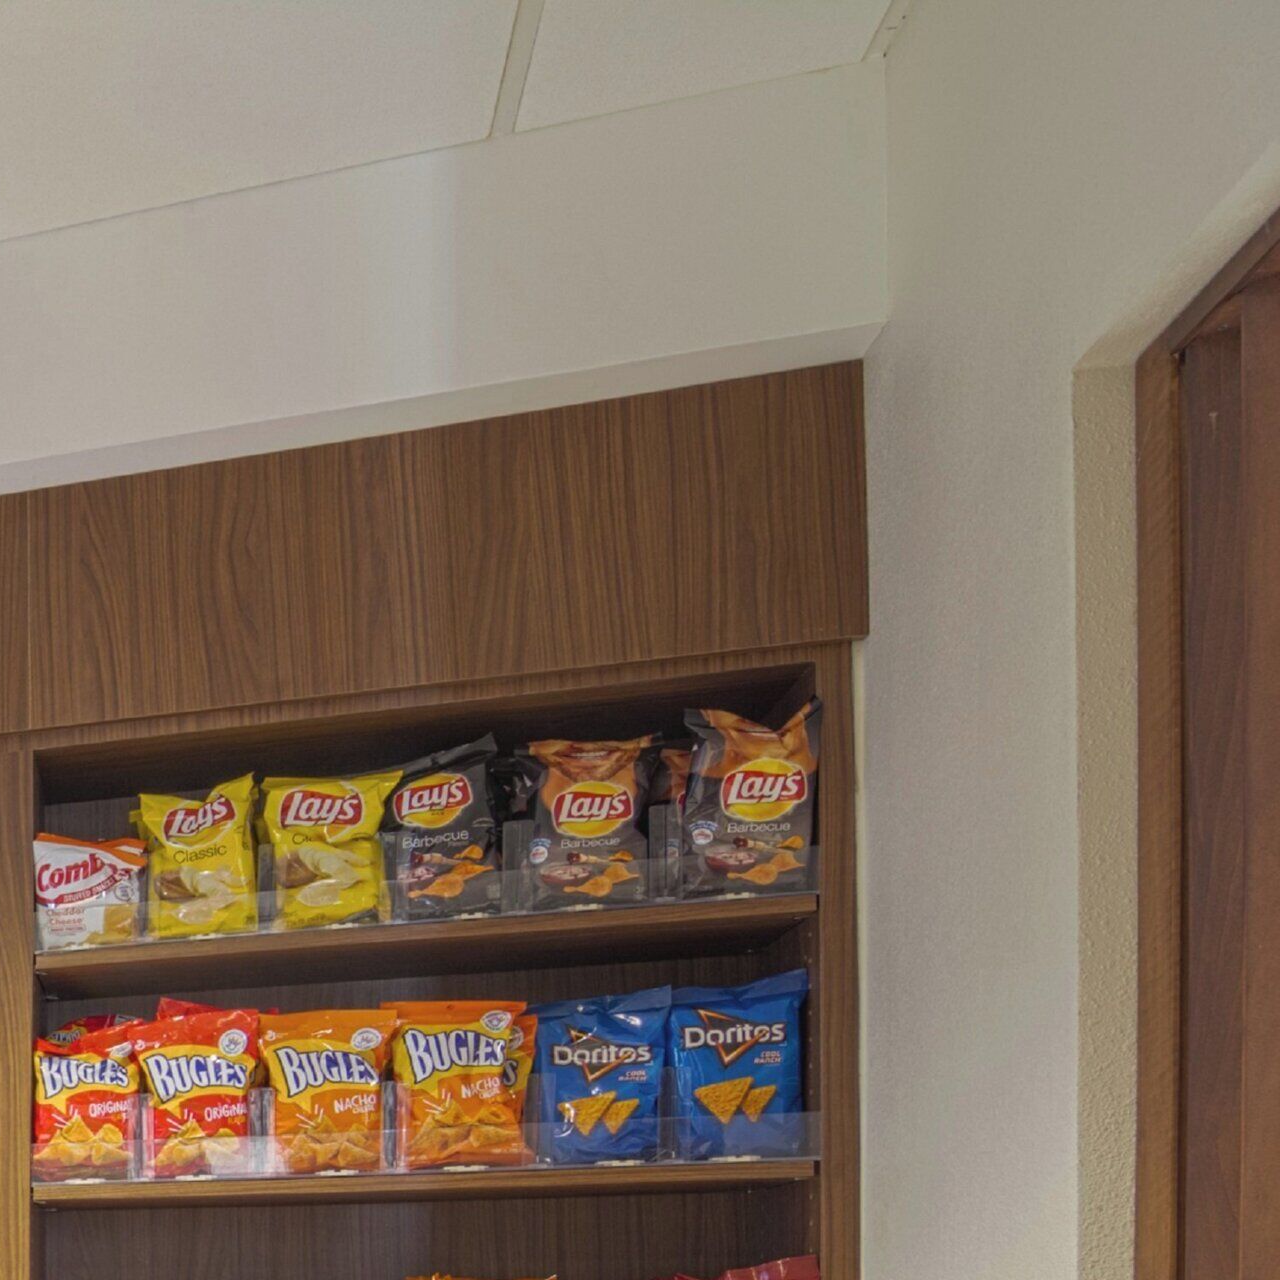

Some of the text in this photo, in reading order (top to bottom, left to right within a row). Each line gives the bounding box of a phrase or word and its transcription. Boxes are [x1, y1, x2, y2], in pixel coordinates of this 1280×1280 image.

[401, 778, 471, 818] Lay's
[730, 771, 803, 804] Lay's
[167, 796, 234, 837] Lay's
[284, 792, 360, 825] Lay's
[559, 793, 630, 823] Lay's
[402, 829, 470, 850] Barbecue
[727, 821, 791, 834] Barbecue
[173, 843, 228, 865] Classic
[561, 837, 621, 850] Barbecue
[37, 853, 108, 892] Comb
[684, 1022, 786, 1048] Doritos
[404, 1028, 507, 1083] BUGLES
[553, 1044, 652, 1065] Doritos
[40, 1055, 129, 1099] BUGLES
[147, 1054, 247, 1105] BUGLES
[276, 1047, 379, 1098] BUGLES
[334, 1094, 377, 1114] NACHO
[461, 1077, 501, 1100] NACHO
